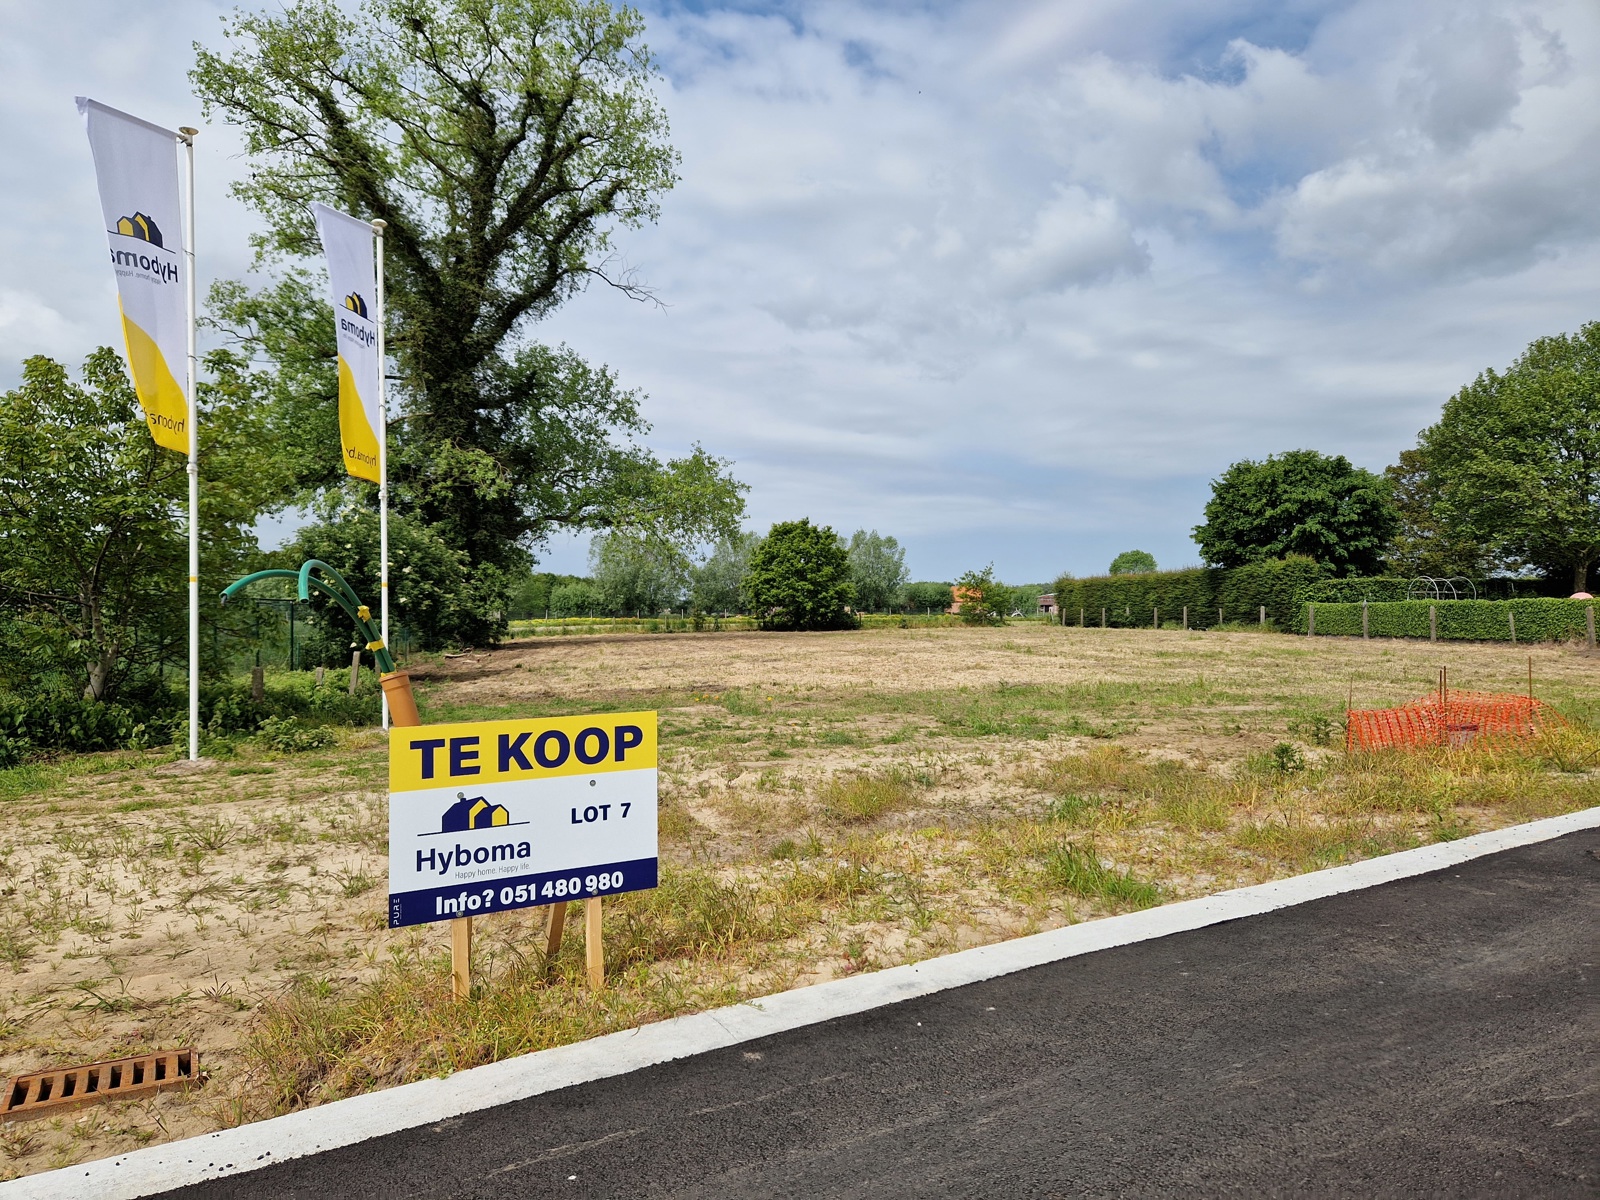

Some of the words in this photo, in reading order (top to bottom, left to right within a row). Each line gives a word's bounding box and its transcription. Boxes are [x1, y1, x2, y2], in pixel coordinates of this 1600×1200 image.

[410, 735, 481, 779] TE
[498, 725, 643, 772] KOOP
[571, 804, 611, 824] LOT
[620, 802, 631, 818] 7
[416, 841, 531, 875] Hyboma
[455, 871, 476, 880] Happy
[477, 868, 497, 876] home.
[499, 864, 519, 874] Happy
[520, 862, 531, 870] life.
[436, 889, 494, 915] Info?
[500, 883, 537, 905] 051
[541, 877, 581, 898] 480
[585, 871, 624, 894] 980
